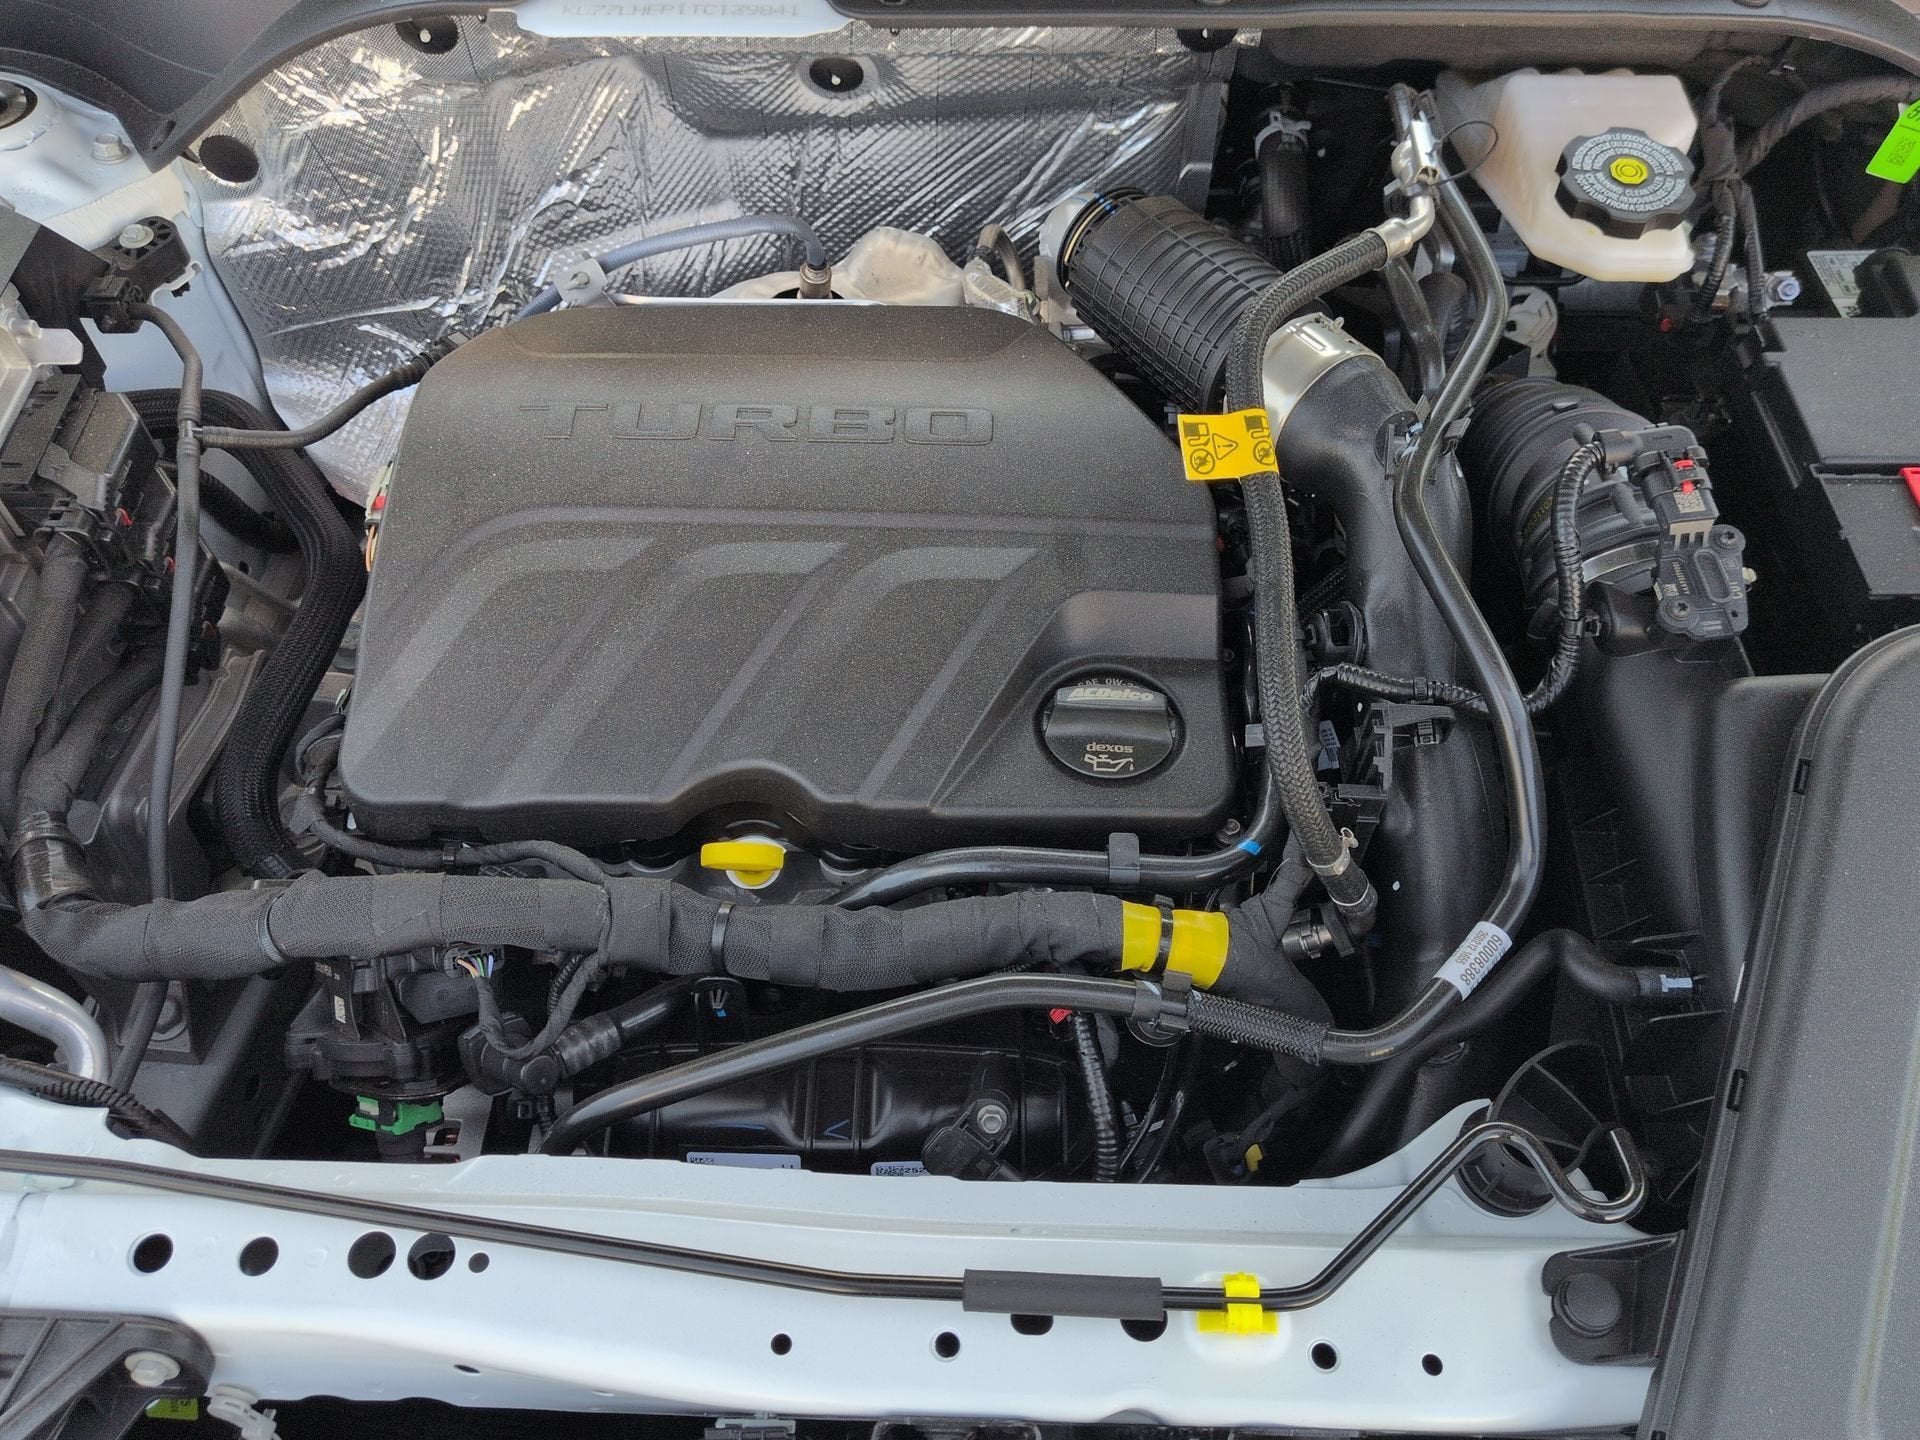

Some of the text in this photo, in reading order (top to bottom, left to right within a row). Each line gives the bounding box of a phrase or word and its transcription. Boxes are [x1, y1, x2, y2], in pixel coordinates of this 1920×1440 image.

[519, 402, 995, 446] TURBO
[1066, 687, 1154, 701] ACDelco
[1086, 742, 1135, 753] dexos
[1460, 933, 1504, 986] 60008388
